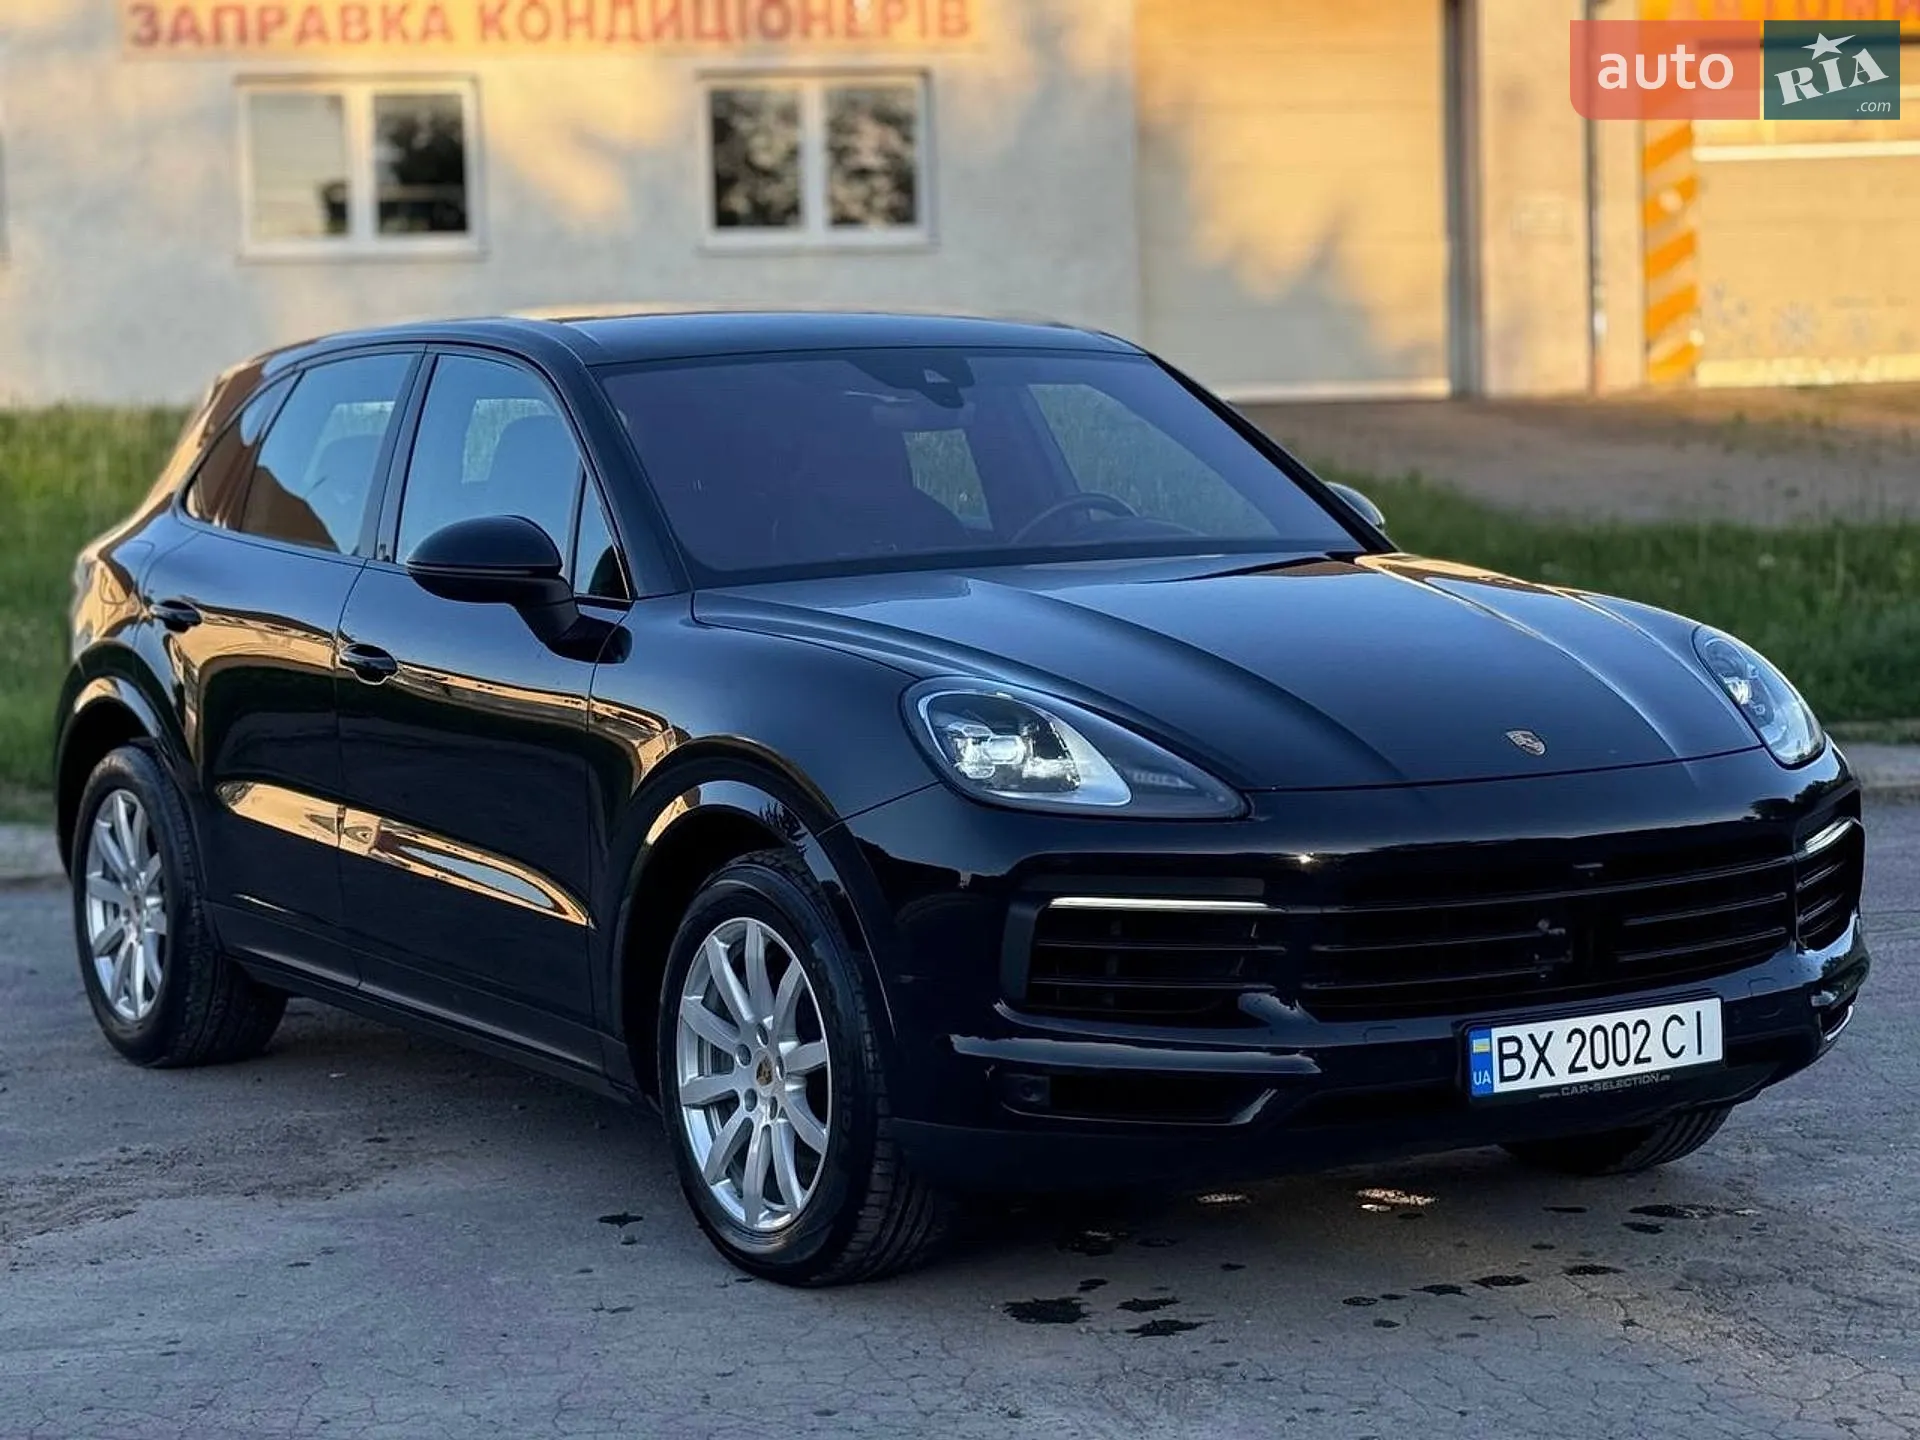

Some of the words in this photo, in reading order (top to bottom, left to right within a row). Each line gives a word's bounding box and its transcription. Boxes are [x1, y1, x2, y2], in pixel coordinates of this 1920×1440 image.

[129, 3, 455, 47] ЗАПРАВКА
[478, 0, 972, 43] КОНДИЦІОНЕРІВ
[1497, 1031, 1556, 1083] BX
[1566, 1019, 1651, 1074] 2002
[1662, 1010, 1702, 1059] CI
[1473, 1070, 1492, 1086] UA
